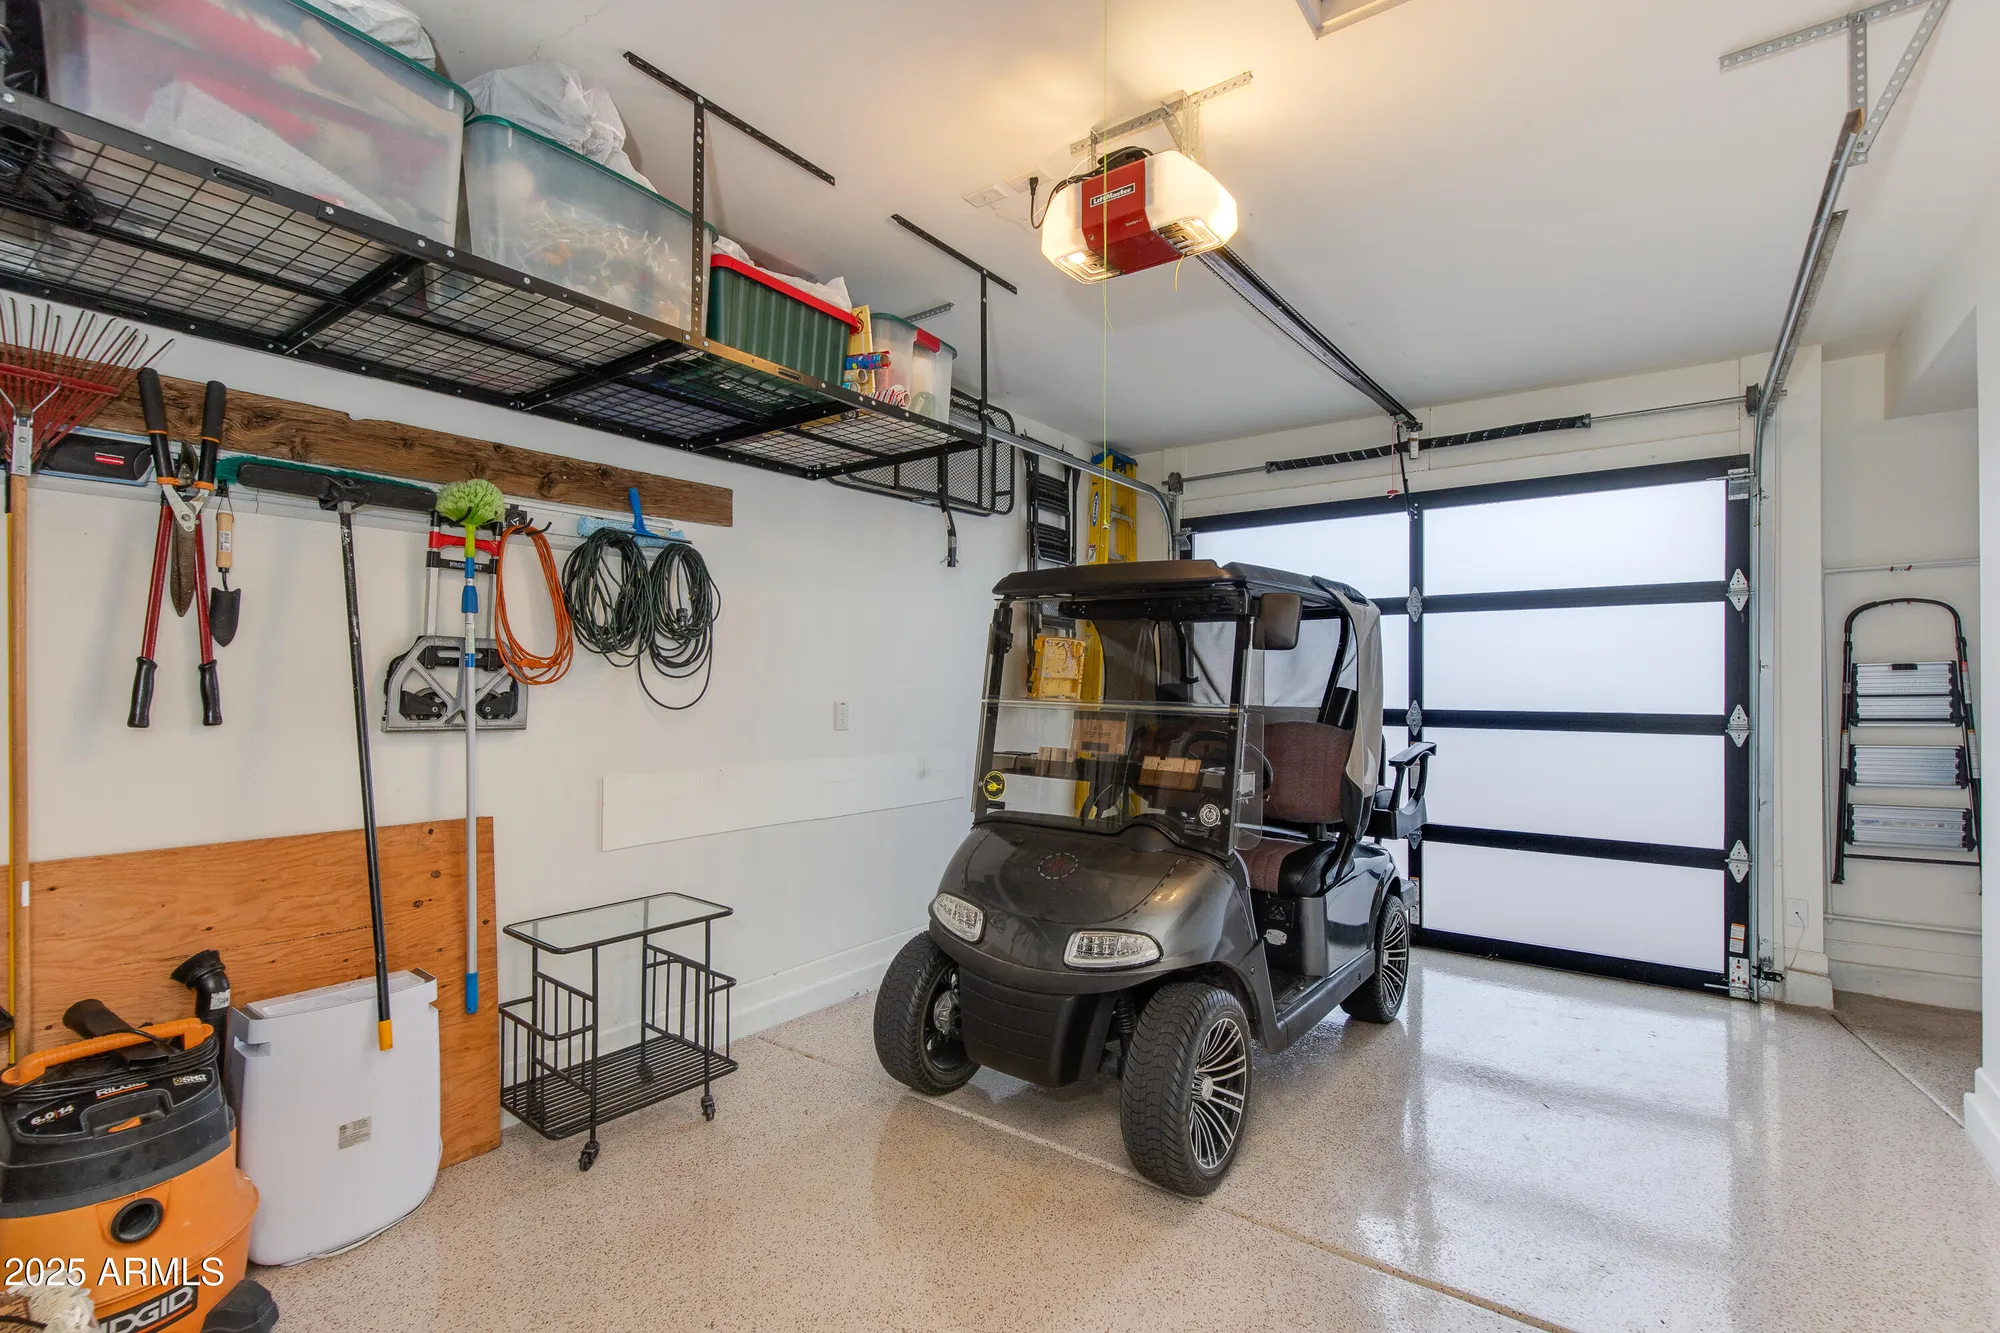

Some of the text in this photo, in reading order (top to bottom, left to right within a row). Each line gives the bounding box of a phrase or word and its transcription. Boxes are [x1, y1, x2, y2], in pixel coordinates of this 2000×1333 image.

[449, 561, 483, 570] MAGNRT
[95, 1082, 147, 1097] RID
[100, 1286, 193, 1333] IDGID
